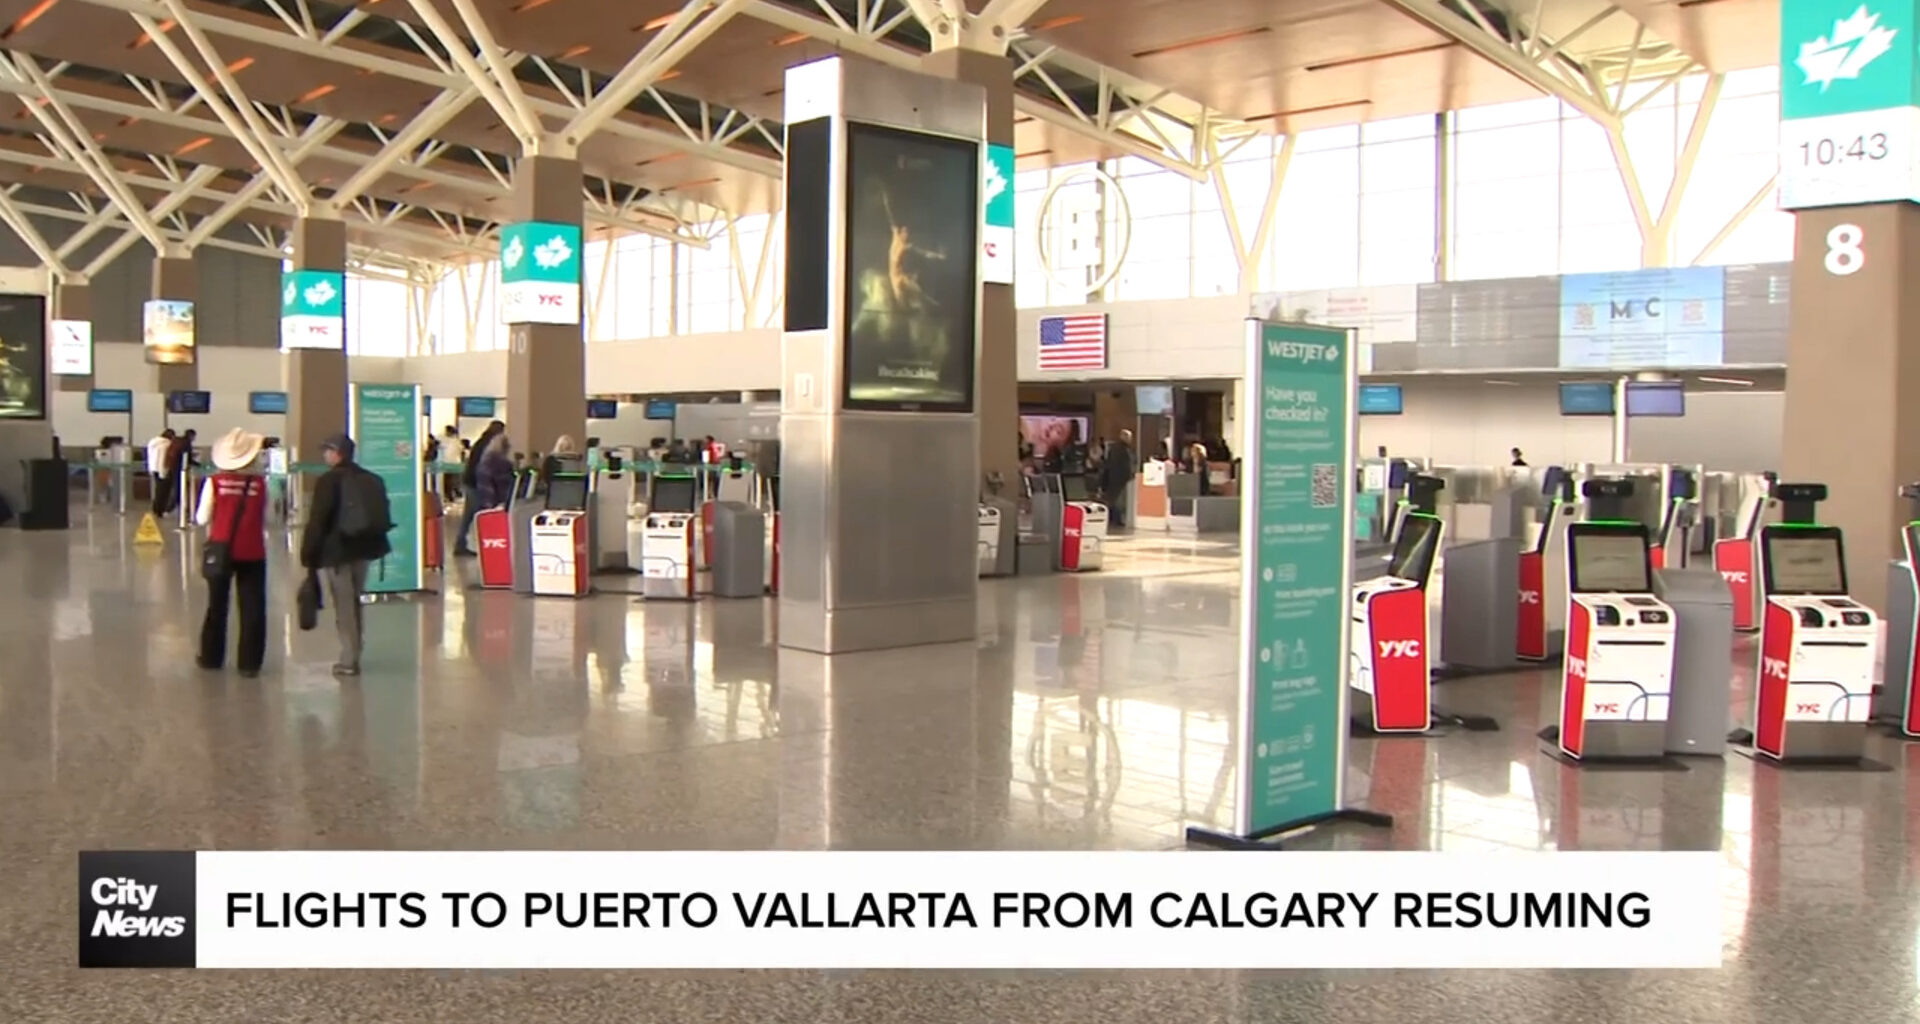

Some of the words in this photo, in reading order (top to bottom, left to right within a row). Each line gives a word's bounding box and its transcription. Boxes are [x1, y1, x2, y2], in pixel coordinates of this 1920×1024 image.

[1800, 132, 1889, 167] 10:43
[1824, 223, 1865, 276] 8
[538, 294, 563, 306] YYC
[511, 332, 527, 354] 10
[1268, 340, 1325, 365] WESTJET
[1265, 386, 1295, 402] Have
[1296, 391, 1318, 406] you
[1265, 405, 1311, 421] checked
[482, 538, 507, 549] YYC
[1720, 571, 1748, 583] YYC
[1378, 640, 1420, 658] YYC
[1764, 656, 1787, 679] YYC
[1594, 703, 1618, 713] YYC
[1796, 703, 1820, 714] YYC
